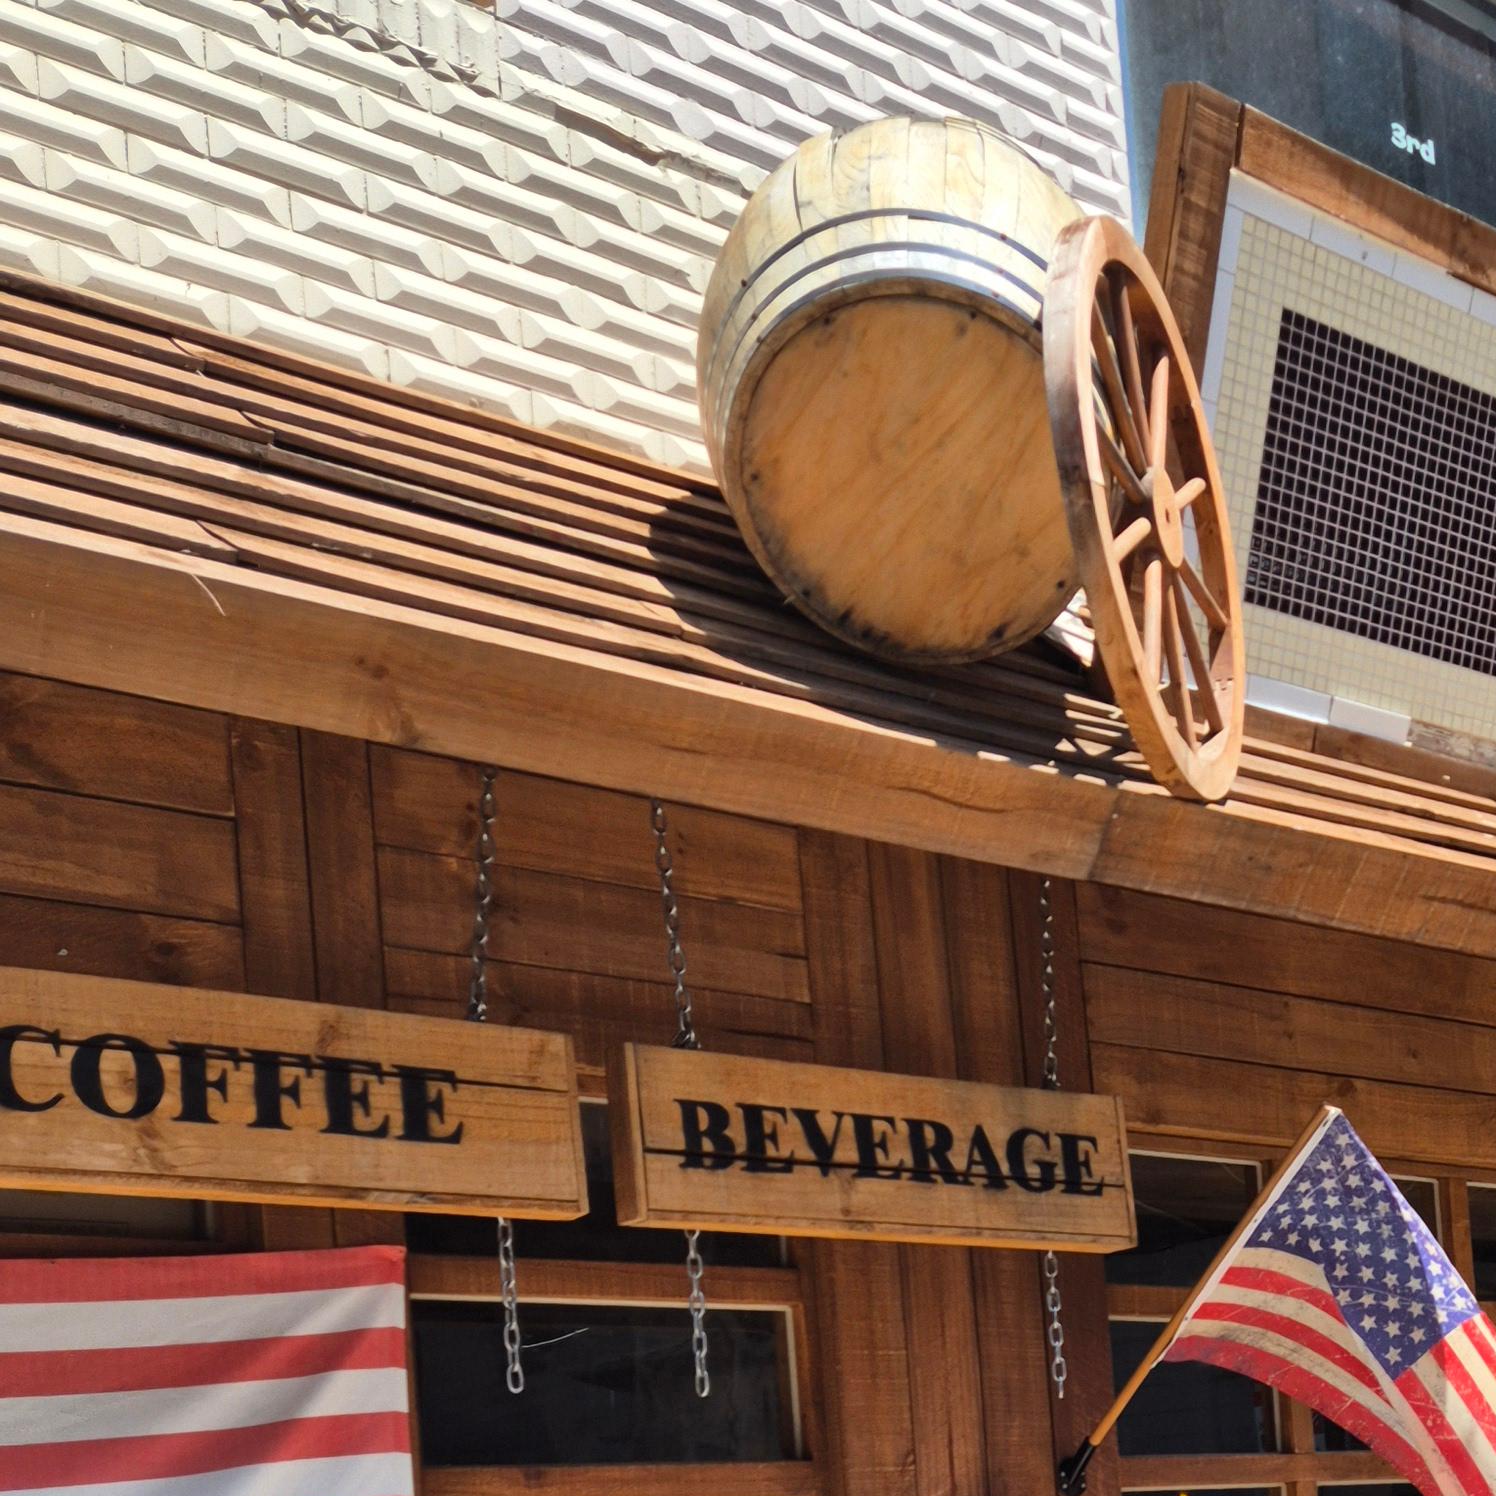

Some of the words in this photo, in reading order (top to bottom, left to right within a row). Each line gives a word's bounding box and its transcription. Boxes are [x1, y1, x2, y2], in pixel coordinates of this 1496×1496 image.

[1391, 122, 1436, 165] 3rd
[0, 1024, 464, 1144] COFFEE
[674, 1098, 1104, 1197] BEVERAGE
